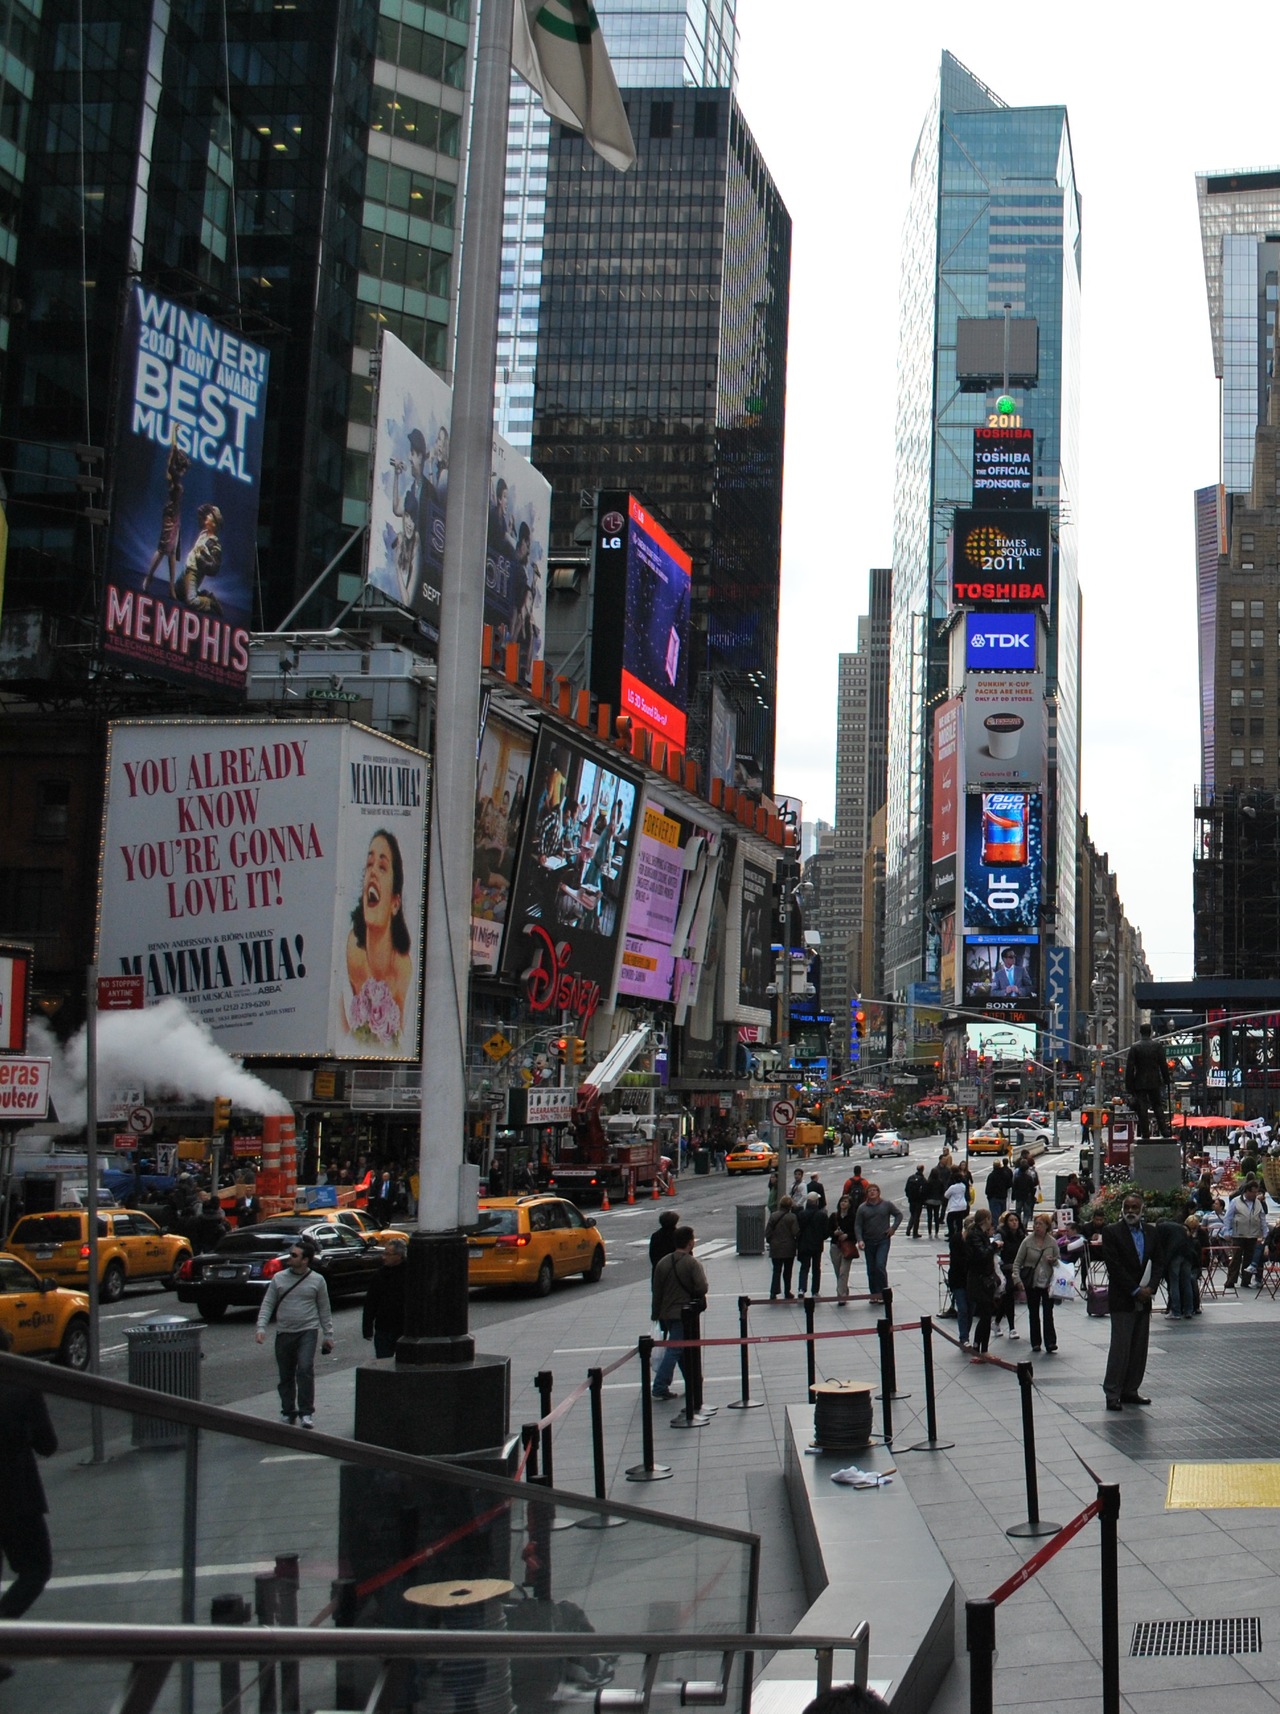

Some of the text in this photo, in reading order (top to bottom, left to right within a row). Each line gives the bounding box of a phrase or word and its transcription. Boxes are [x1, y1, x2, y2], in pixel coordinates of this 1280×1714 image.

[136, 287, 265, 382] WINNER!
[139, 325, 260, 402] 2010 TONY AWARD
[135, 350, 257, 450] BEST
[988, 414, 1020, 427] 2011
[975, 428, 1032, 438] TOSHIBA
[133, 403, 252, 483] MUSICAL
[975, 452, 1031, 463] TOSHIBA
[988, 466, 1030, 475] OFFICIAL
[975, 480, 1021, 489] SPONSOR
[602, 537, 622, 549] LG
[994, 538, 1027, 548] TIMES
[1001, 547, 1042, 557] SQUARE
[954, 583, 1046, 599] TOSHIBA
[106, 583, 250, 672] MEMPHIS
[984, 633, 1030, 648] TDK
[311, 689, 357, 701] LAMAR
[122, 740, 309, 798] YOU ALREADY
[350, 761, 421, 808] MAMMA MIA!
[992, 794, 1024, 802] BUD
[176, 788, 261, 833] KNOW
[984, 802, 1025, 810] LIGHT
[119, 822, 325, 882] YOU'RE GONNA
[167, 867, 284, 918] LOVE IT!
[988, 873, 1020, 910] OF
[172, 936, 213, 949] ANDERSSON
[214, 935, 219, 943] &
[221, 932, 244, 943] BJÖRN
[238, 933, 307, 986] MIA!
[101, 979, 140, 988] NO STOPPING
[107, 989, 134, 997] ANYTIME
[202, 989, 233, 1003] MUSICAL
[258, 984, 283, 995] ABBA
[1165, 1046, 1196, 1056] Broadway
